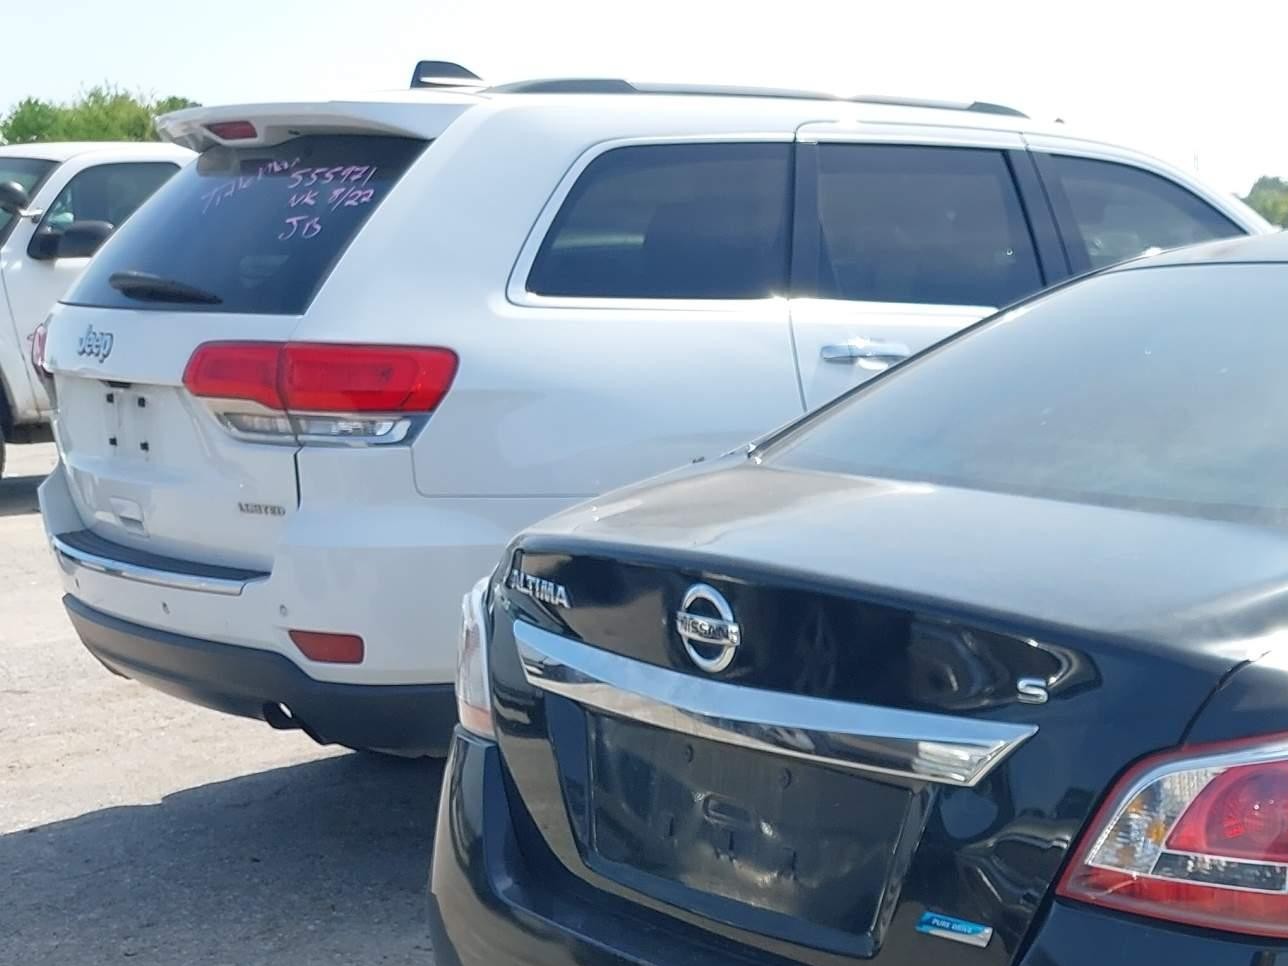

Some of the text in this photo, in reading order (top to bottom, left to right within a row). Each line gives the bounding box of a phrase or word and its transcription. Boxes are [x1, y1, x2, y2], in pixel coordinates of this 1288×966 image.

[78, 324, 114, 363] Jeep
[511, 569, 571, 609] ALTIMA
[680, 615, 729, 640] NISSAN
[1017, 678, 1048, 704] S
[931, 918, 951, 929] PURE
